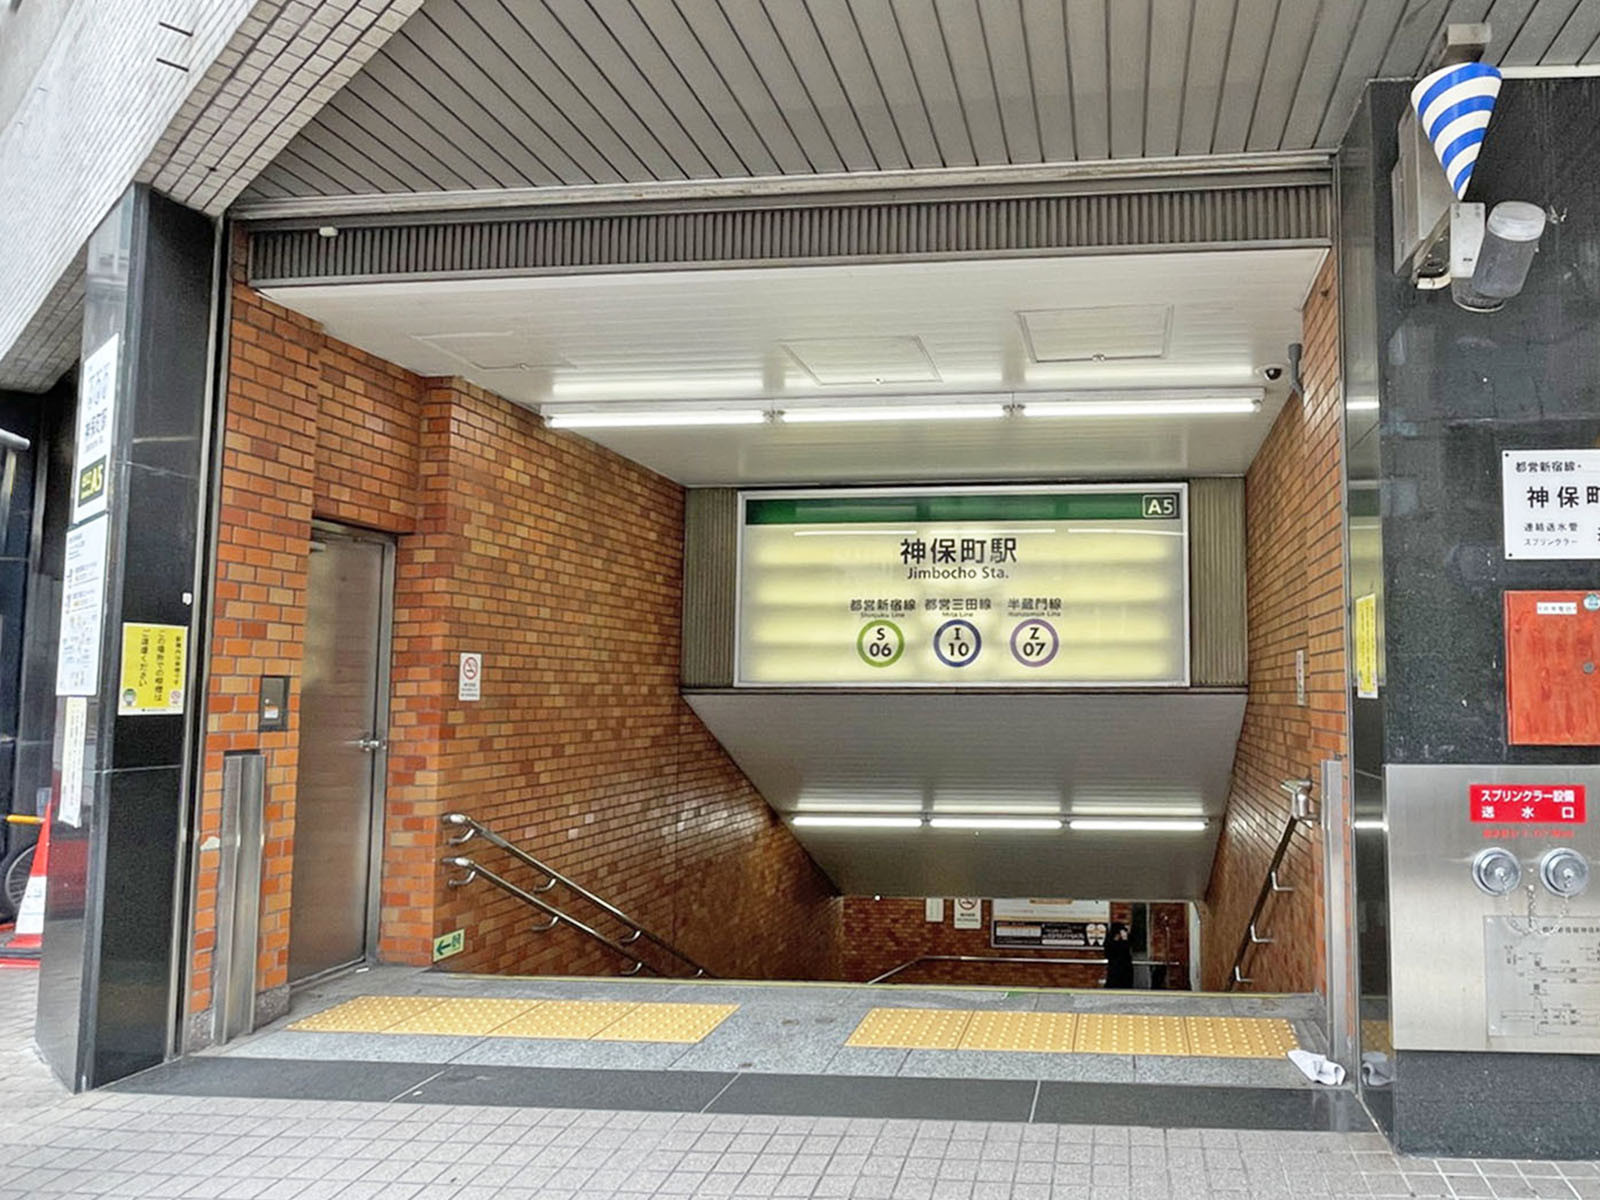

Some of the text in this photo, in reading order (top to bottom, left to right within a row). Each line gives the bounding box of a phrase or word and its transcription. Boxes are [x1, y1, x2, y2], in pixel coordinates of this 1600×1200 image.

[1148, 499, 1174, 515] A5
[1523, 538, 1578, 546] スプリンクラー
[900, 537, 1018, 564] 神保町駅
[906, 566, 1009, 581] Jimbocho Sta.
[850, 599, 916, 612] 都営新宿線
[925, 598, 992, 611] 都営三田線
[1007, 598, 1062, 611] 半蔵門線
[876, 627, 886, 641] S
[953, 627, 961, 641] I
[1029, 627, 1040, 640] Z
[869, 642, 892, 657] 06
[948, 642, 969, 657] 10
[1023, 642, 1046, 657] 07
[1481, 789, 1575, 803] スプリンクラー設備
[1481, 806, 1574, 819] 送水口
